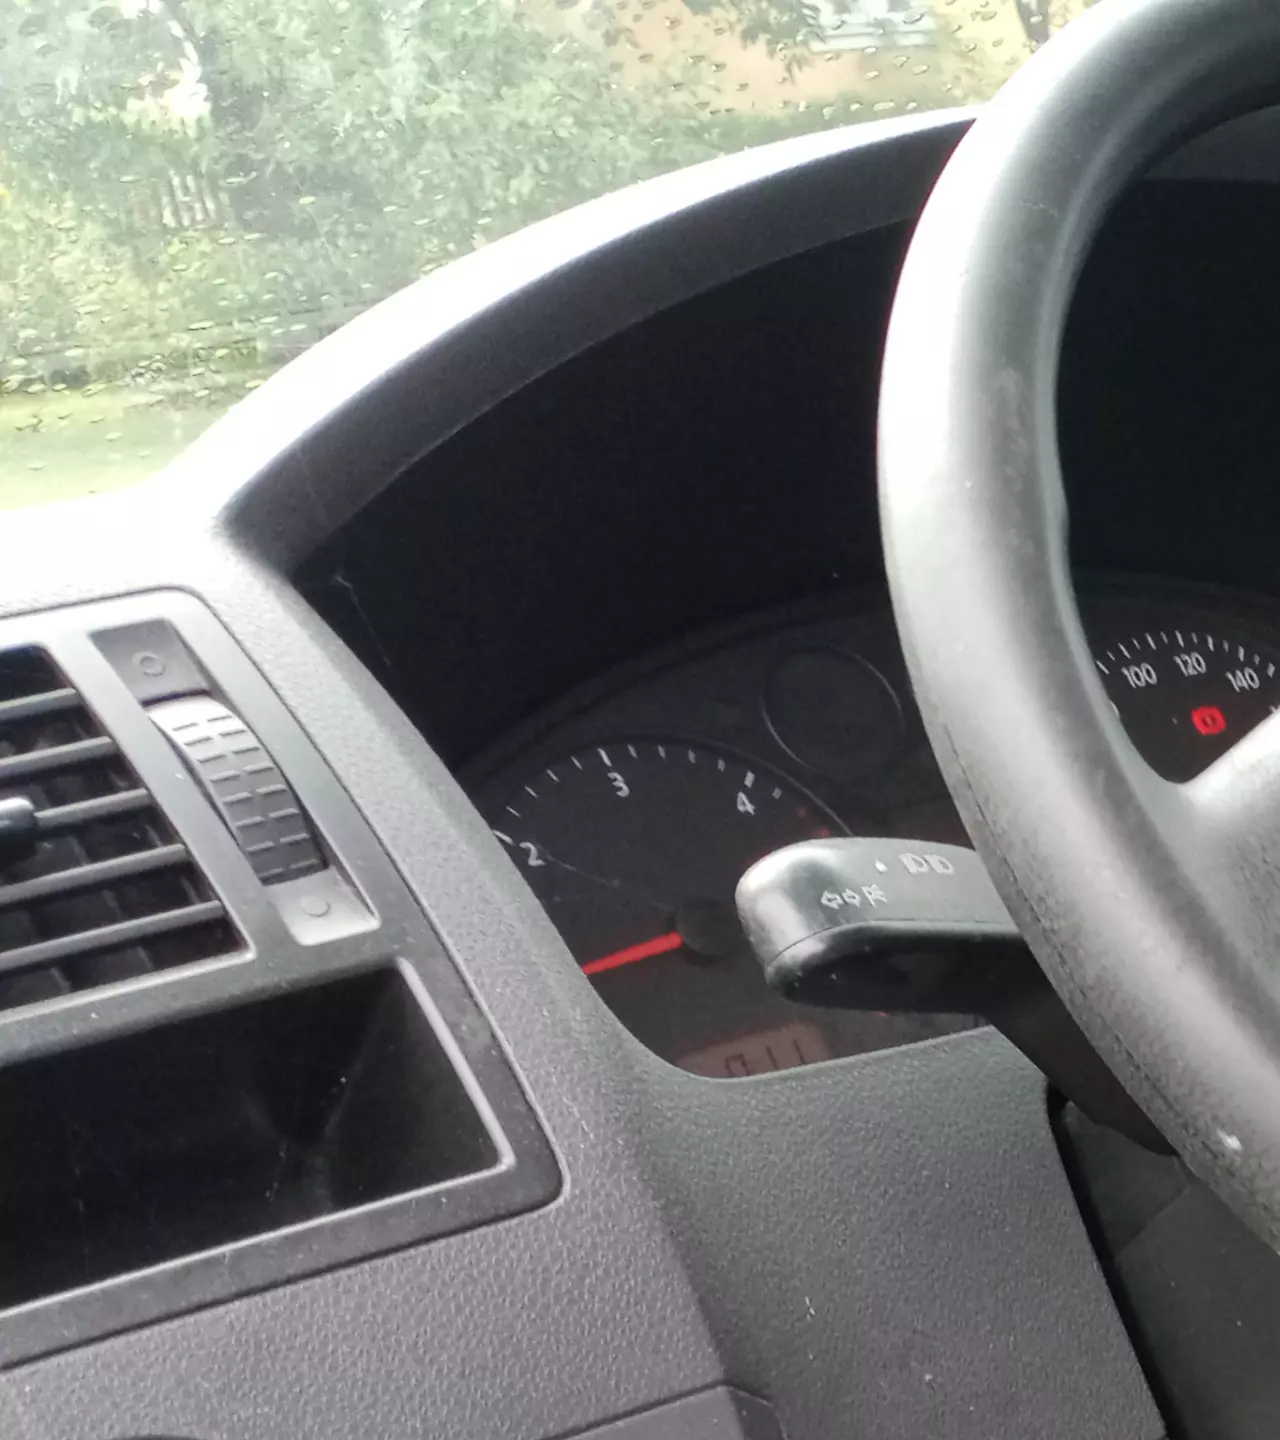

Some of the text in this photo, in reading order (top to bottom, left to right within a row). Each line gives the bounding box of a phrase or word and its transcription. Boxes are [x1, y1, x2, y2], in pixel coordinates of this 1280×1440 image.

[1121, 662, 1158, 688] 100
[1174, 651, 1207, 676] 120
[1225, 667, 1260, 692] 140
[607, 772, 631, 797] 3
[736, 791, 756, 815] 4
[518, 841, 546, 867] 2
